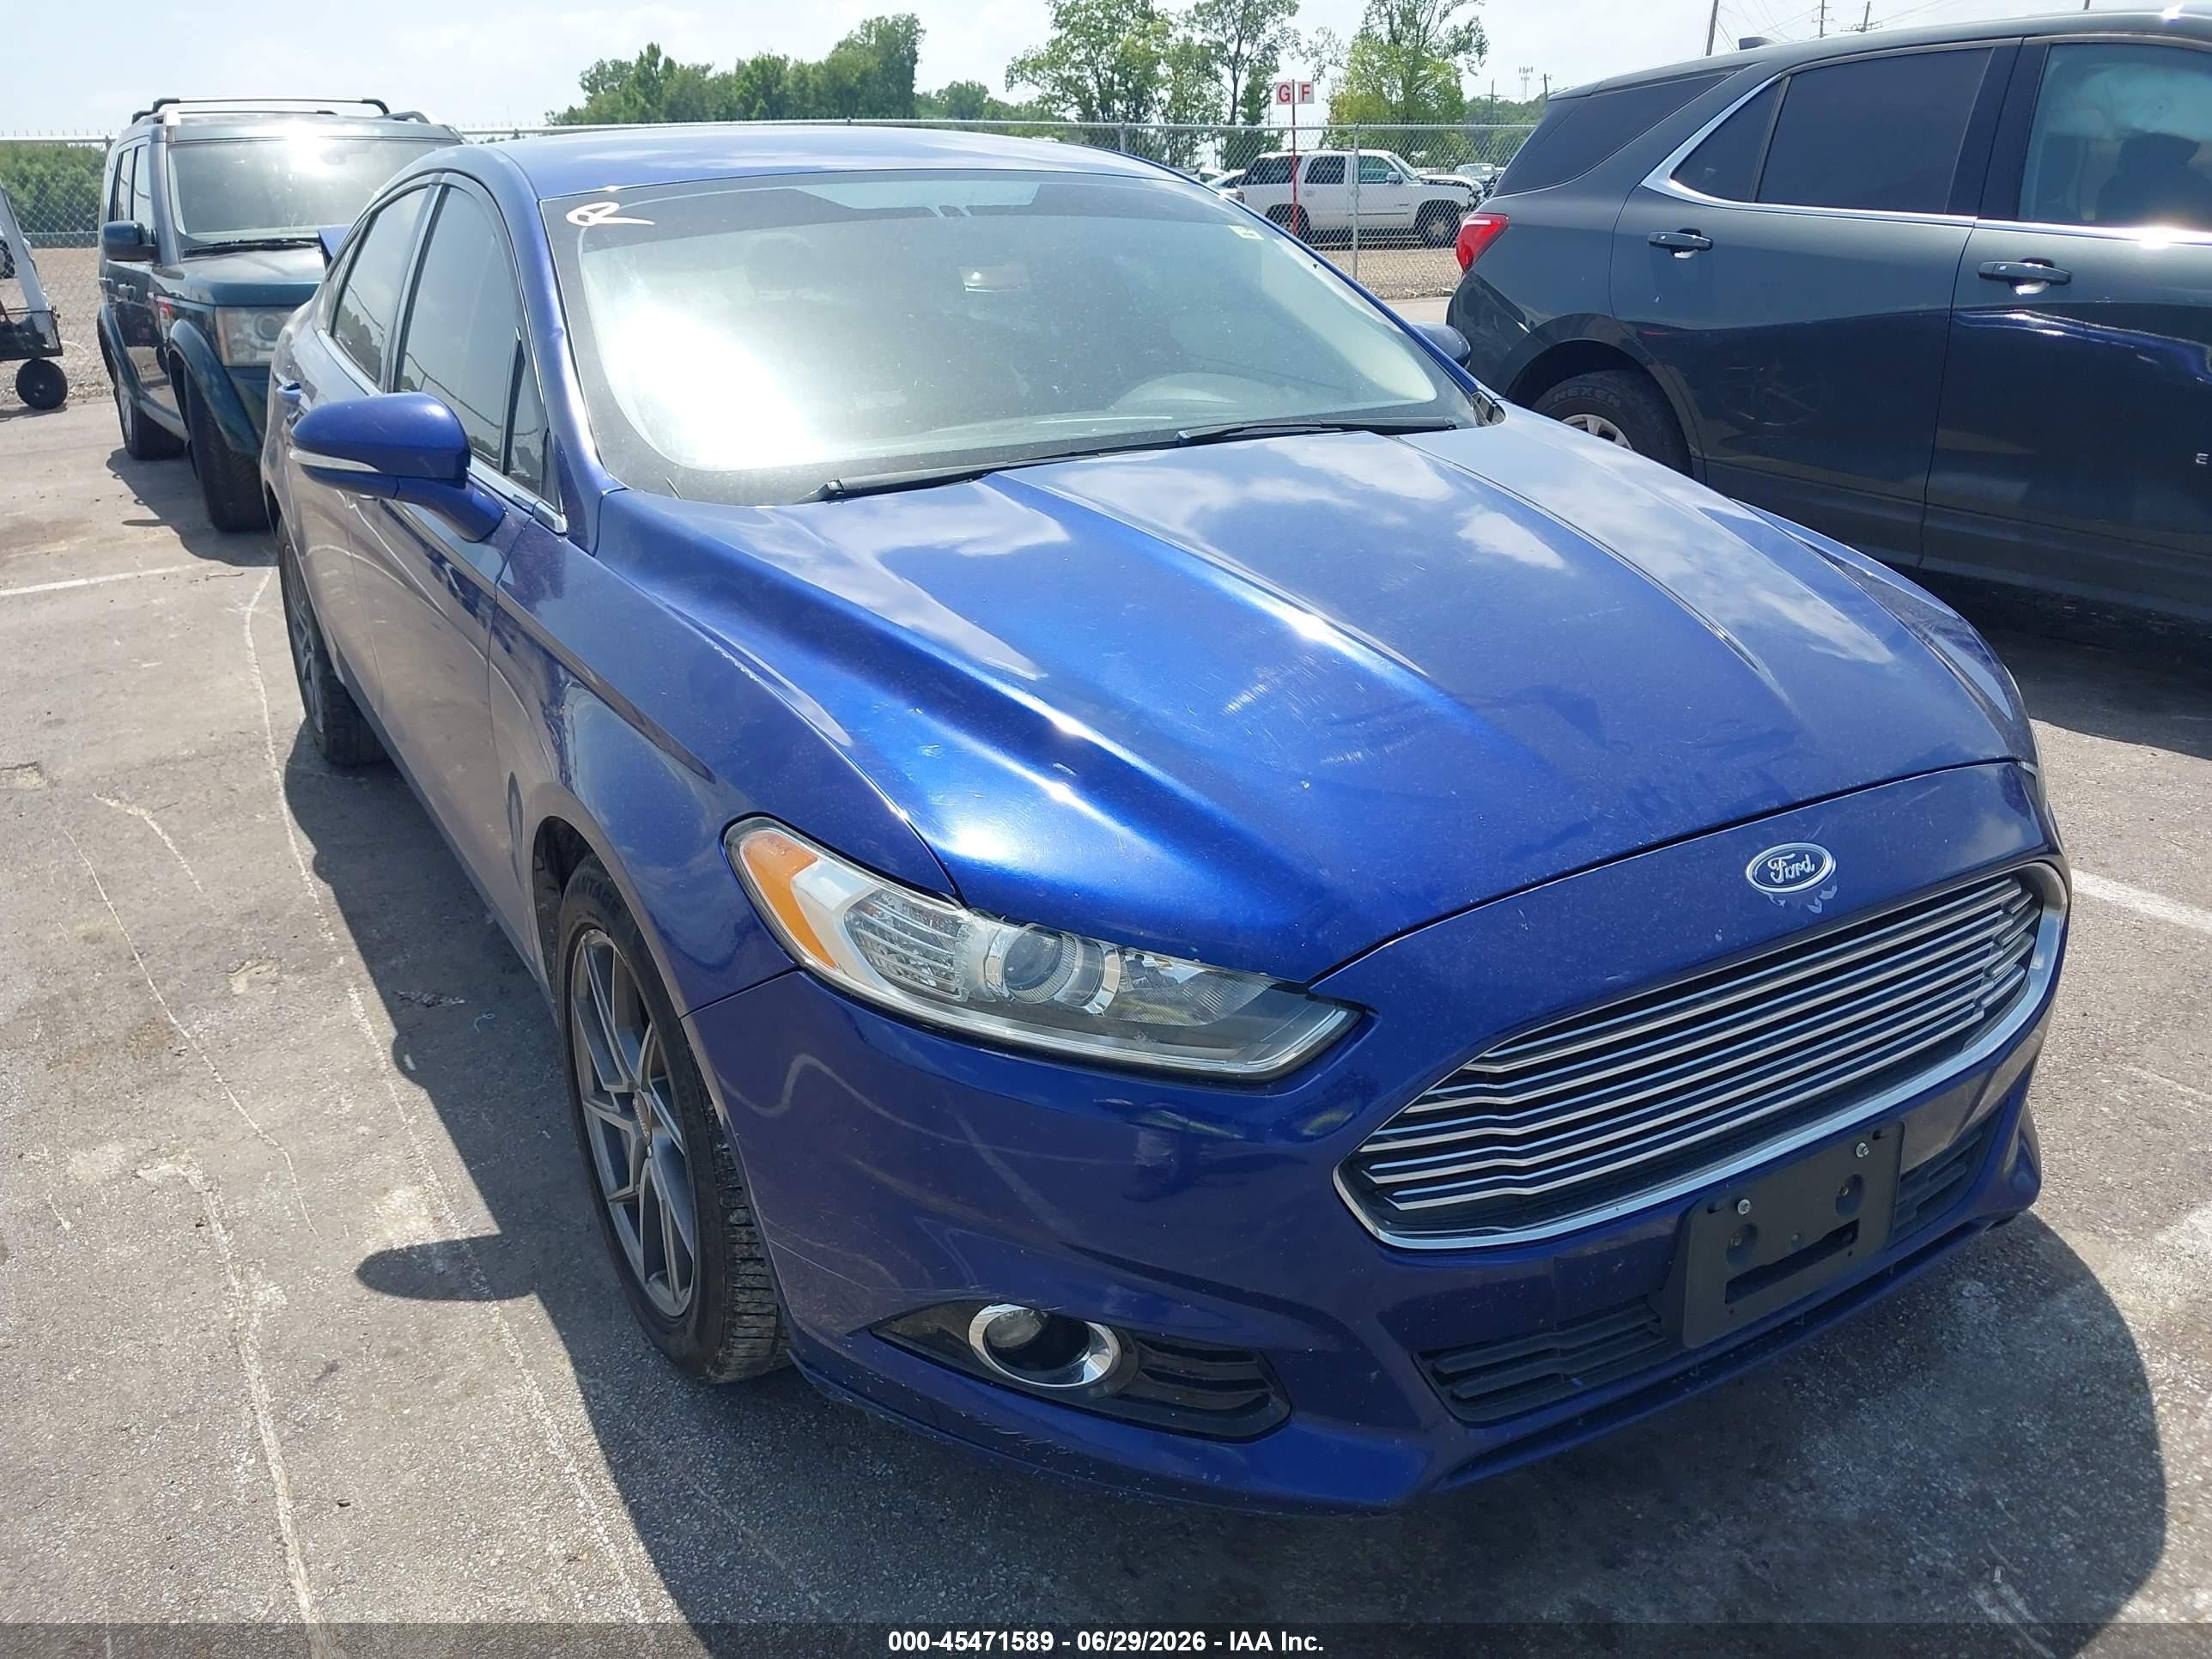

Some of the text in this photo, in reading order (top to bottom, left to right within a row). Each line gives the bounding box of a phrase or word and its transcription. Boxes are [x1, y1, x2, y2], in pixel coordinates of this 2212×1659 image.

[1279, 84, 1291, 103] G
[1301, 83, 1311, 102] F
[1552, 386, 1622, 408] NEXEN
[1767, 853, 1815, 884] Ford
